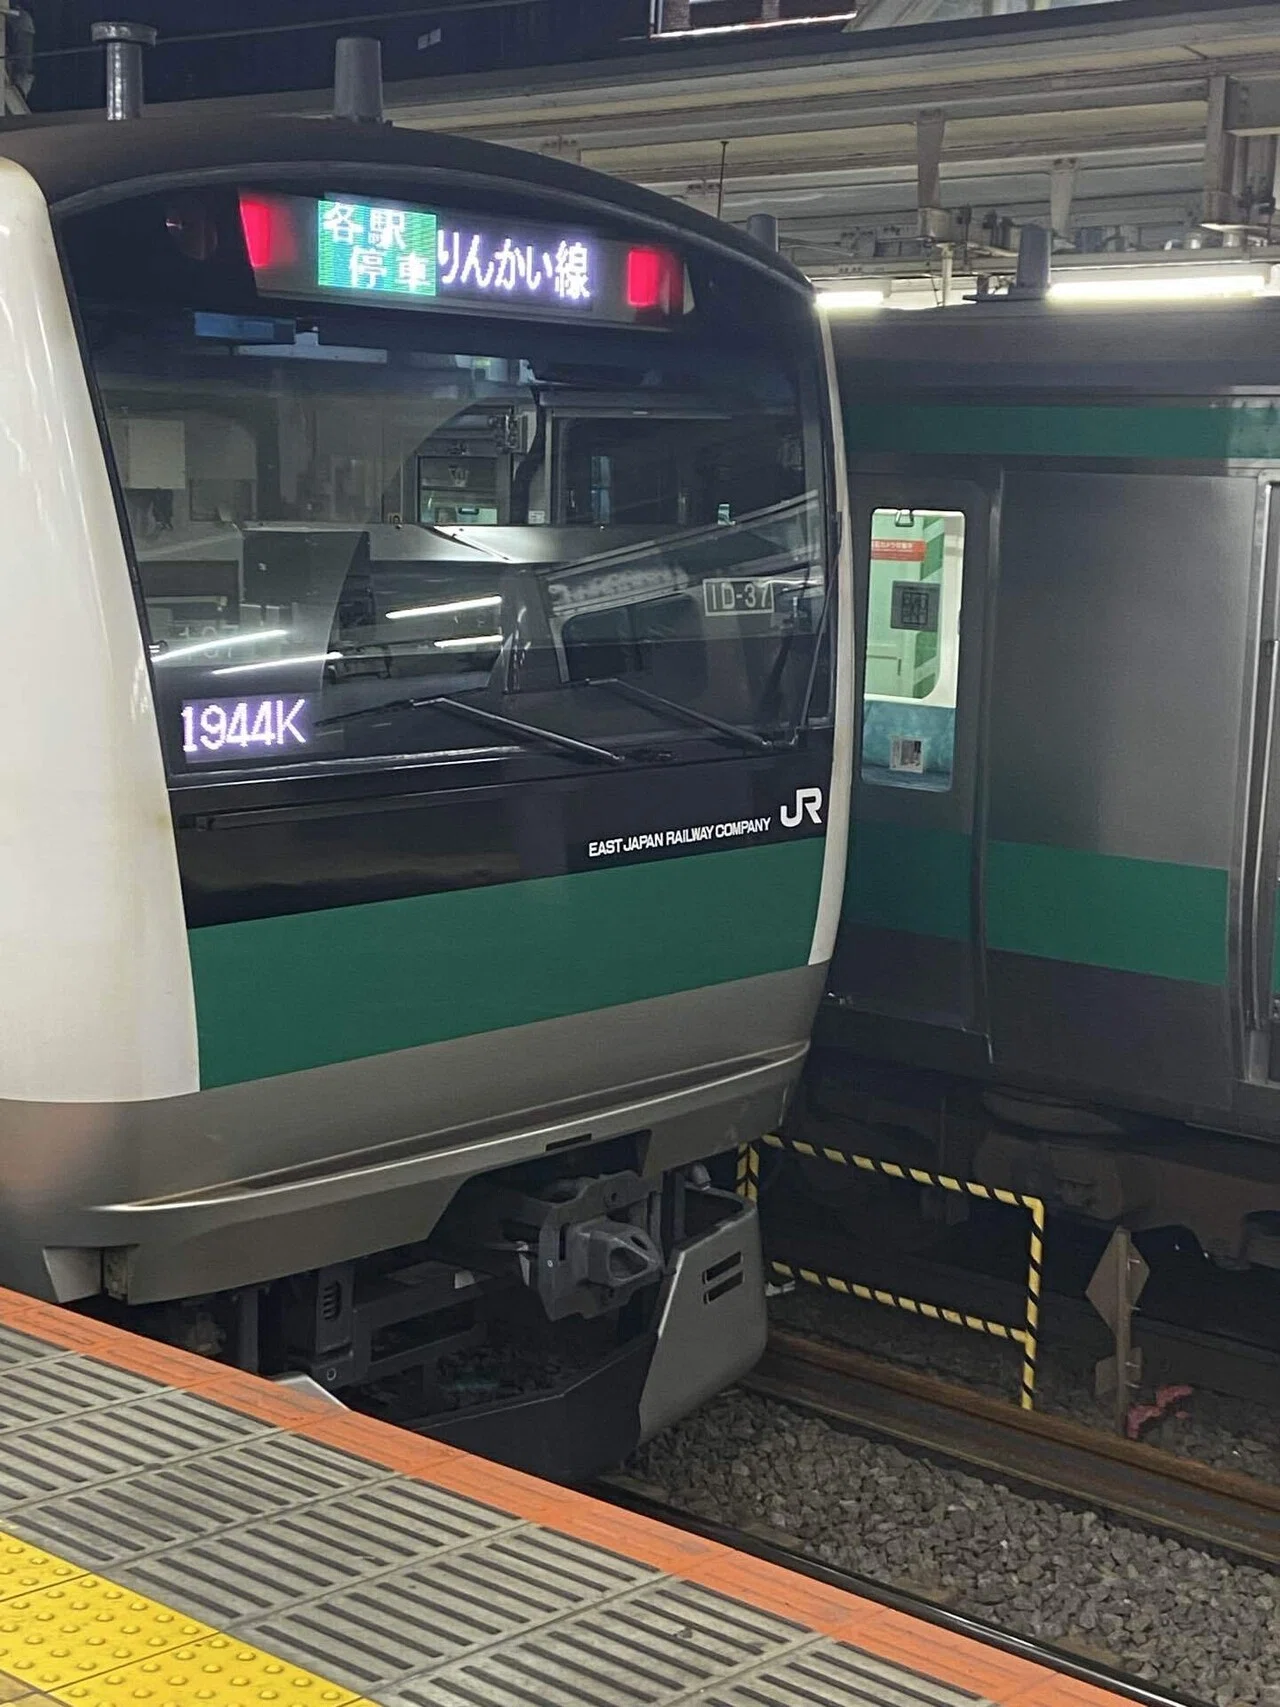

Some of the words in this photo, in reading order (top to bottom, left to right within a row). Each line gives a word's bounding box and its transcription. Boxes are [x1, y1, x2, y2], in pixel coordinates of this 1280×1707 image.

[323, 200, 408, 250] 各駅
[348, 244, 432, 292] 停車
[437, 228, 591, 300] りんかい線
[711, 581, 770, 611] ID-37
[180, 698, 307, 753] 1944K
[780, 787, 822, 828] JR
[588, 838, 623, 857] EAST
[623, 832, 664, 852] JAPAN
[666, 824, 715, 846] RAILWAY
[716, 817, 772, 839] COMPANY
